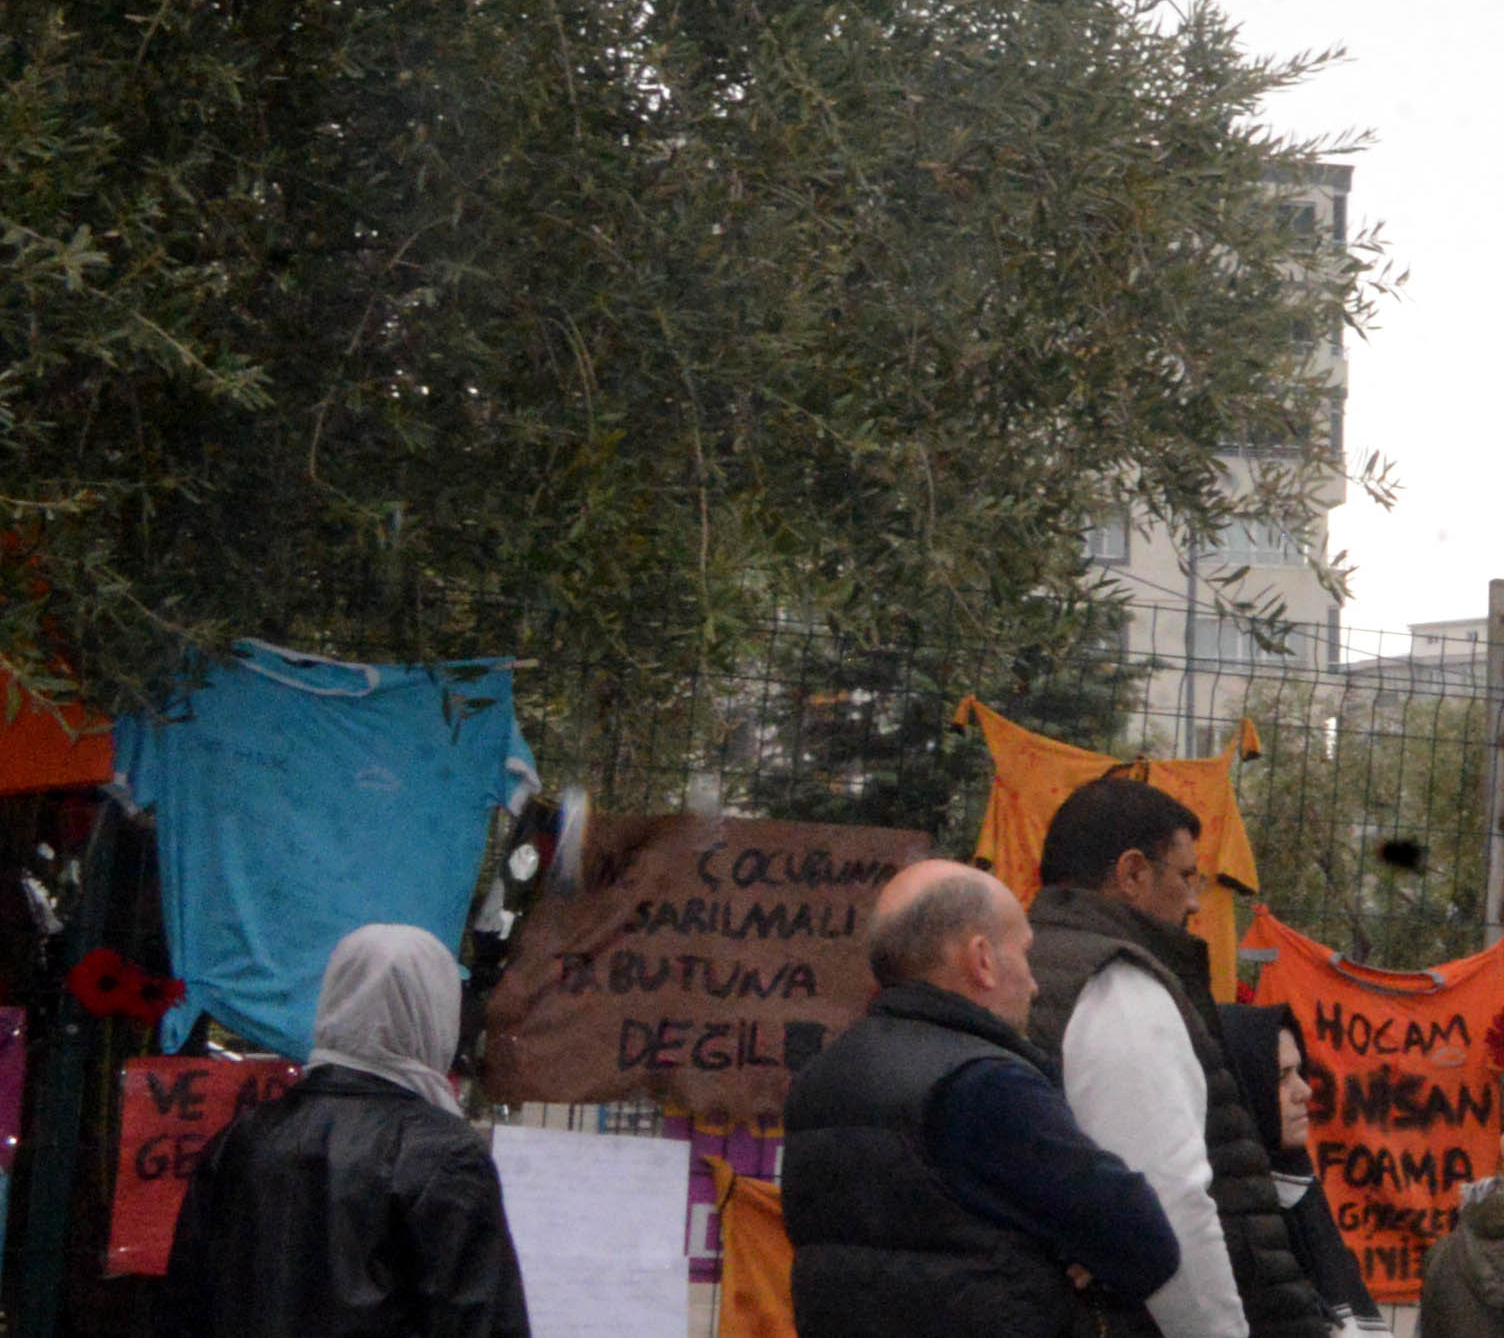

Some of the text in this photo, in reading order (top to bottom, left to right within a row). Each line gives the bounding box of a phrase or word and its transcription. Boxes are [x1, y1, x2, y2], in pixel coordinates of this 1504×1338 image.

[1315, 999, 1472, 1056] HOCAM
[146, 1068, 211, 1121] VE
[1342, 1063, 1493, 1131] NİSAN
